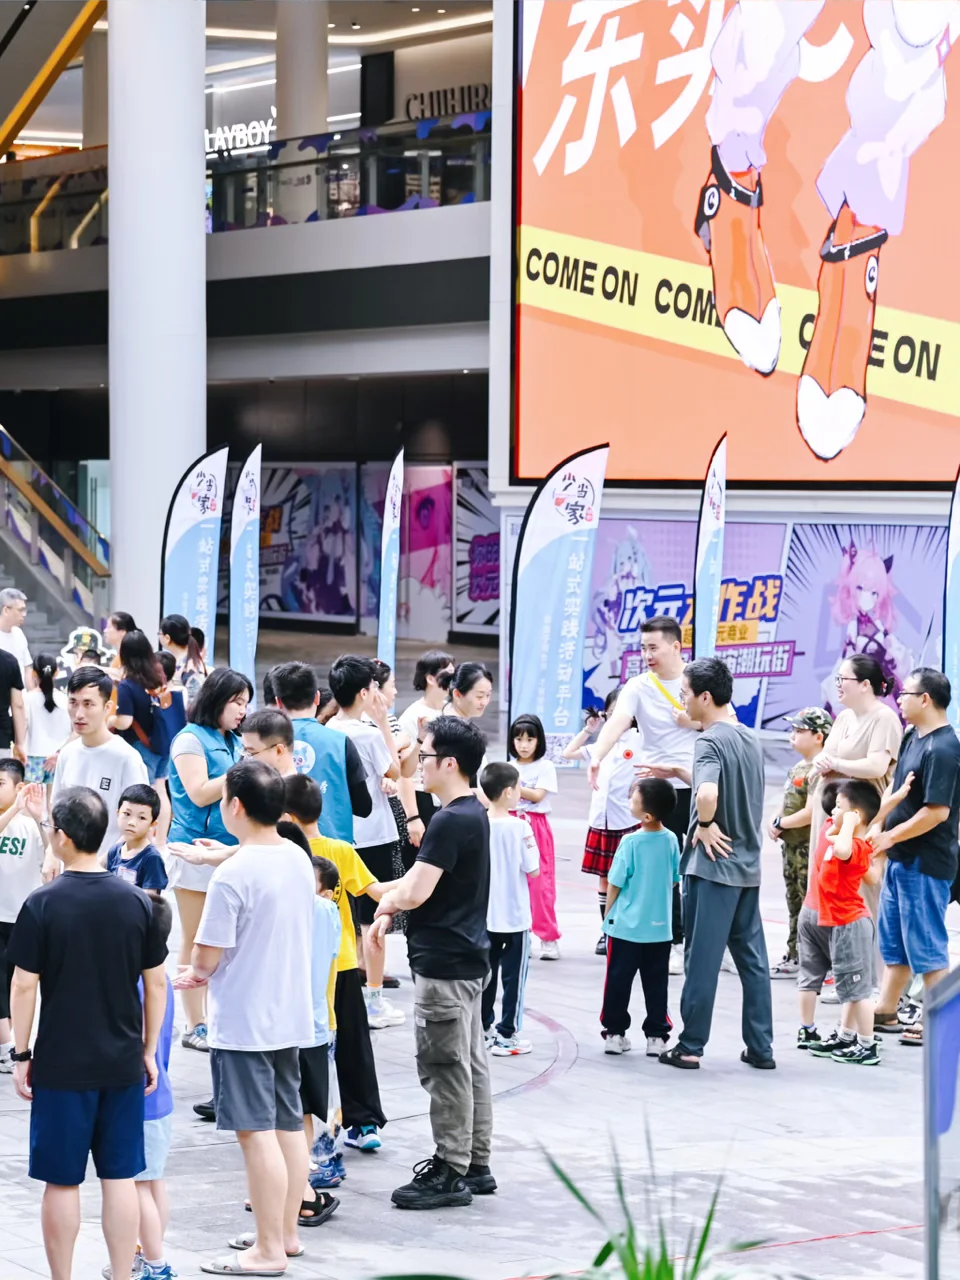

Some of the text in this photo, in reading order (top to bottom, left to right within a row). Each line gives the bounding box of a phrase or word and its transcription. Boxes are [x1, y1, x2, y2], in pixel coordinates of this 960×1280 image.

[526, 248, 598, 296] COME
[602, 266, 639, 306] ON
[655, 278, 724, 329] COM
[894, 336, 941, 381] ON
[620, 578, 782, 631] 次元作战
